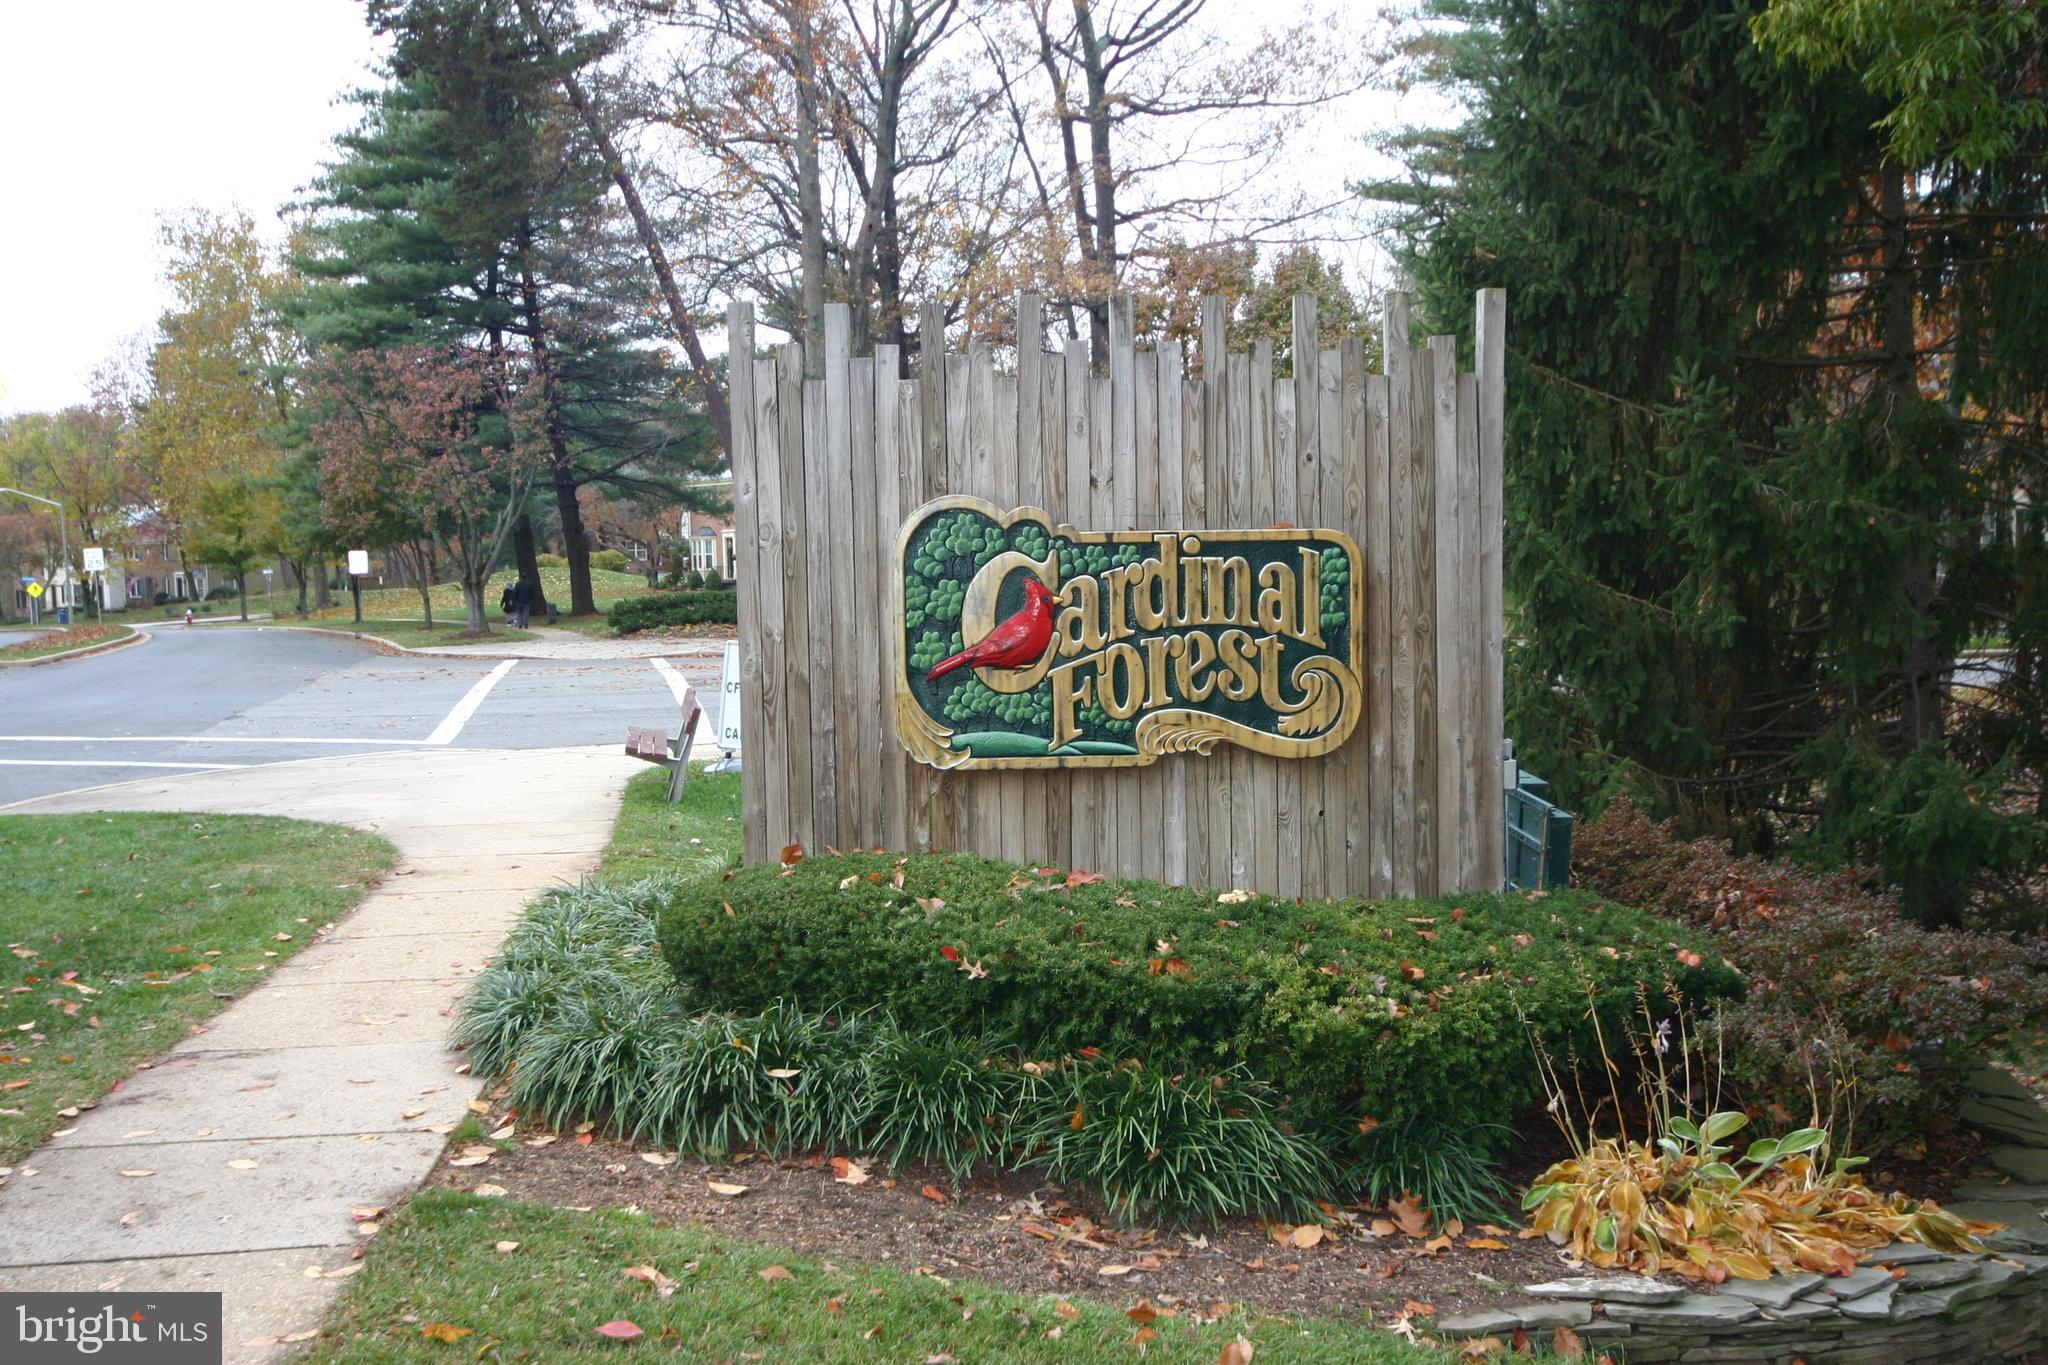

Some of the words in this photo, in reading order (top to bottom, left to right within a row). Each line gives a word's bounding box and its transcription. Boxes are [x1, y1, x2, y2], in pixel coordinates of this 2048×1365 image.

[87, 559, 102, 568] 25
[962, 534, 1327, 694] Cardinal
[1048, 629, 1318, 751] Forest
